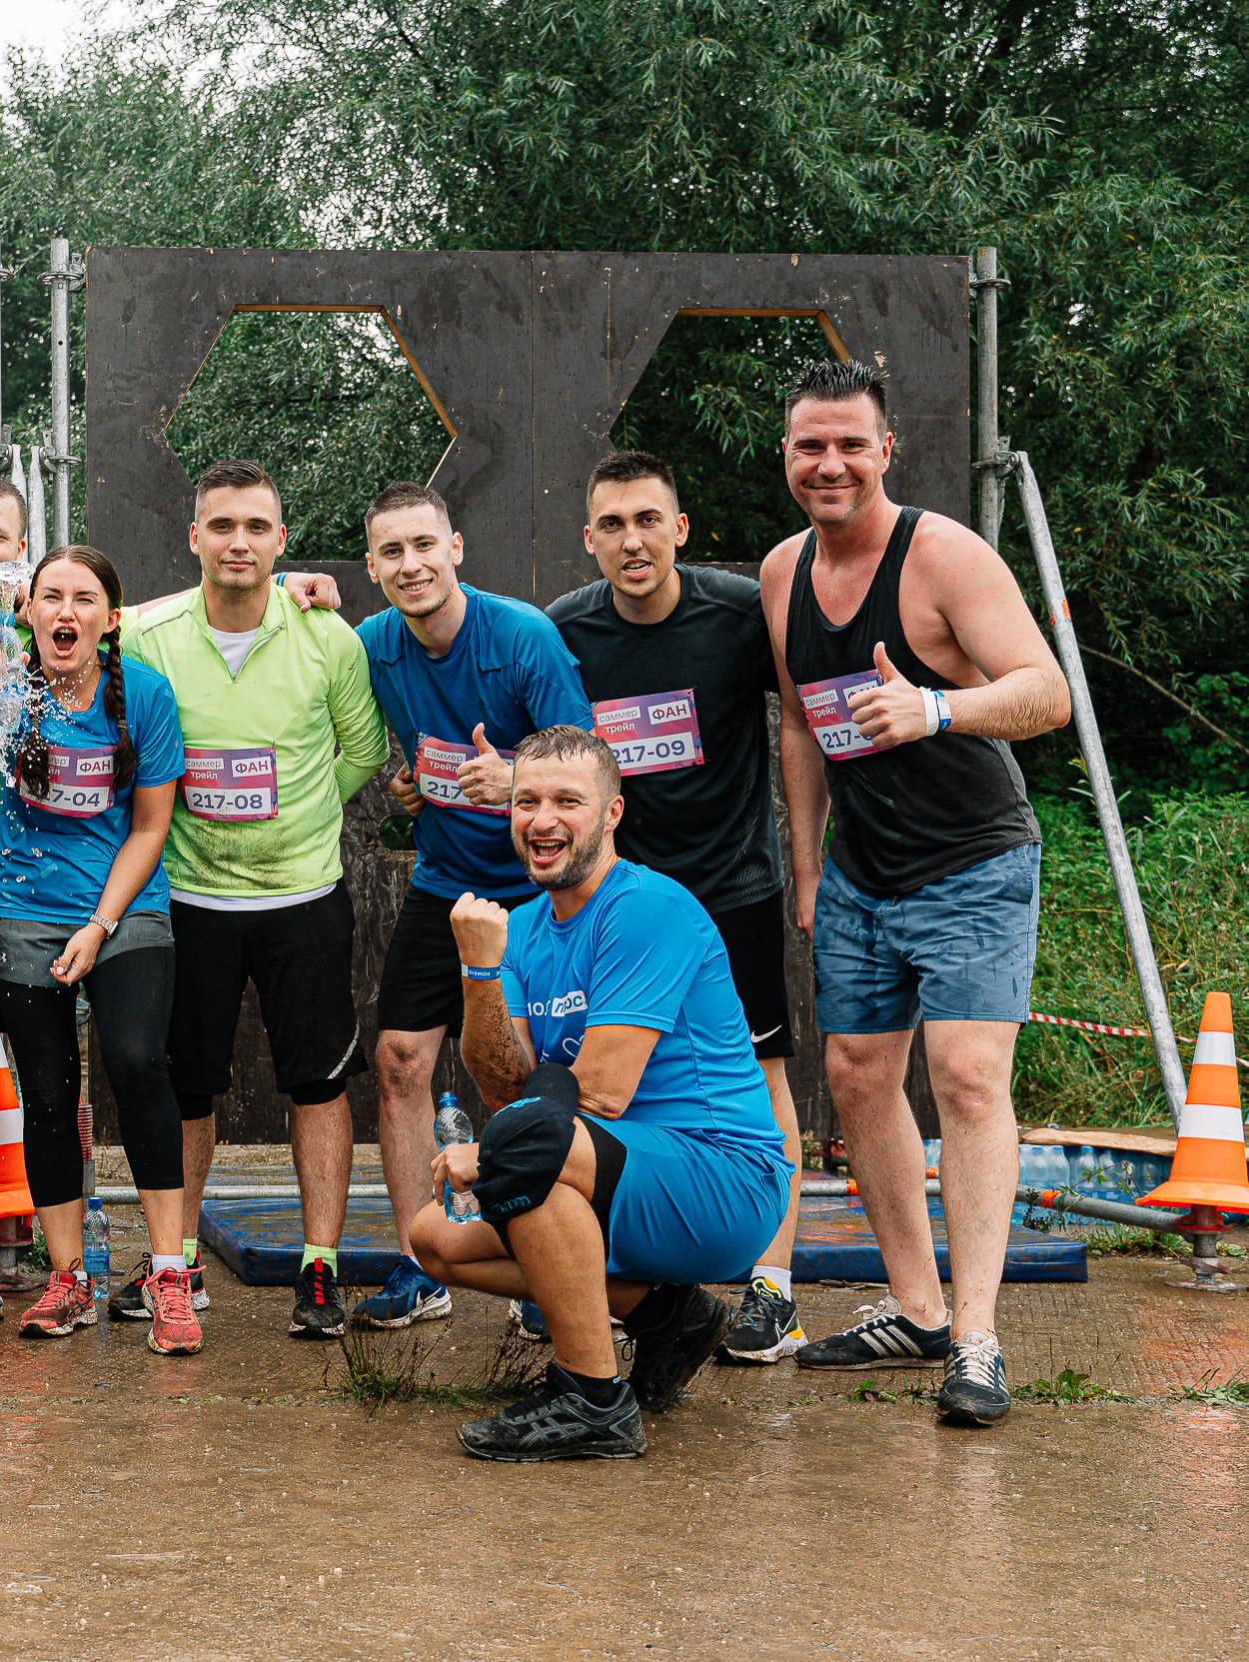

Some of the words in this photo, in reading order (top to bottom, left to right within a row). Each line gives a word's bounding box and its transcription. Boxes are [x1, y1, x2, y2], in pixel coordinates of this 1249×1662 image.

[652, 703, 687, 720] ФАН
[605, 721, 635, 735] трейл
[822, 728, 874, 749] 217-
[611, 740, 686, 764] 217-09
[79, 759, 111, 773] ФАН
[235, 760, 269, 774] ФАН
[190, 770, 218, 780] трейл
[192, 792, 263, 810] 217-08
